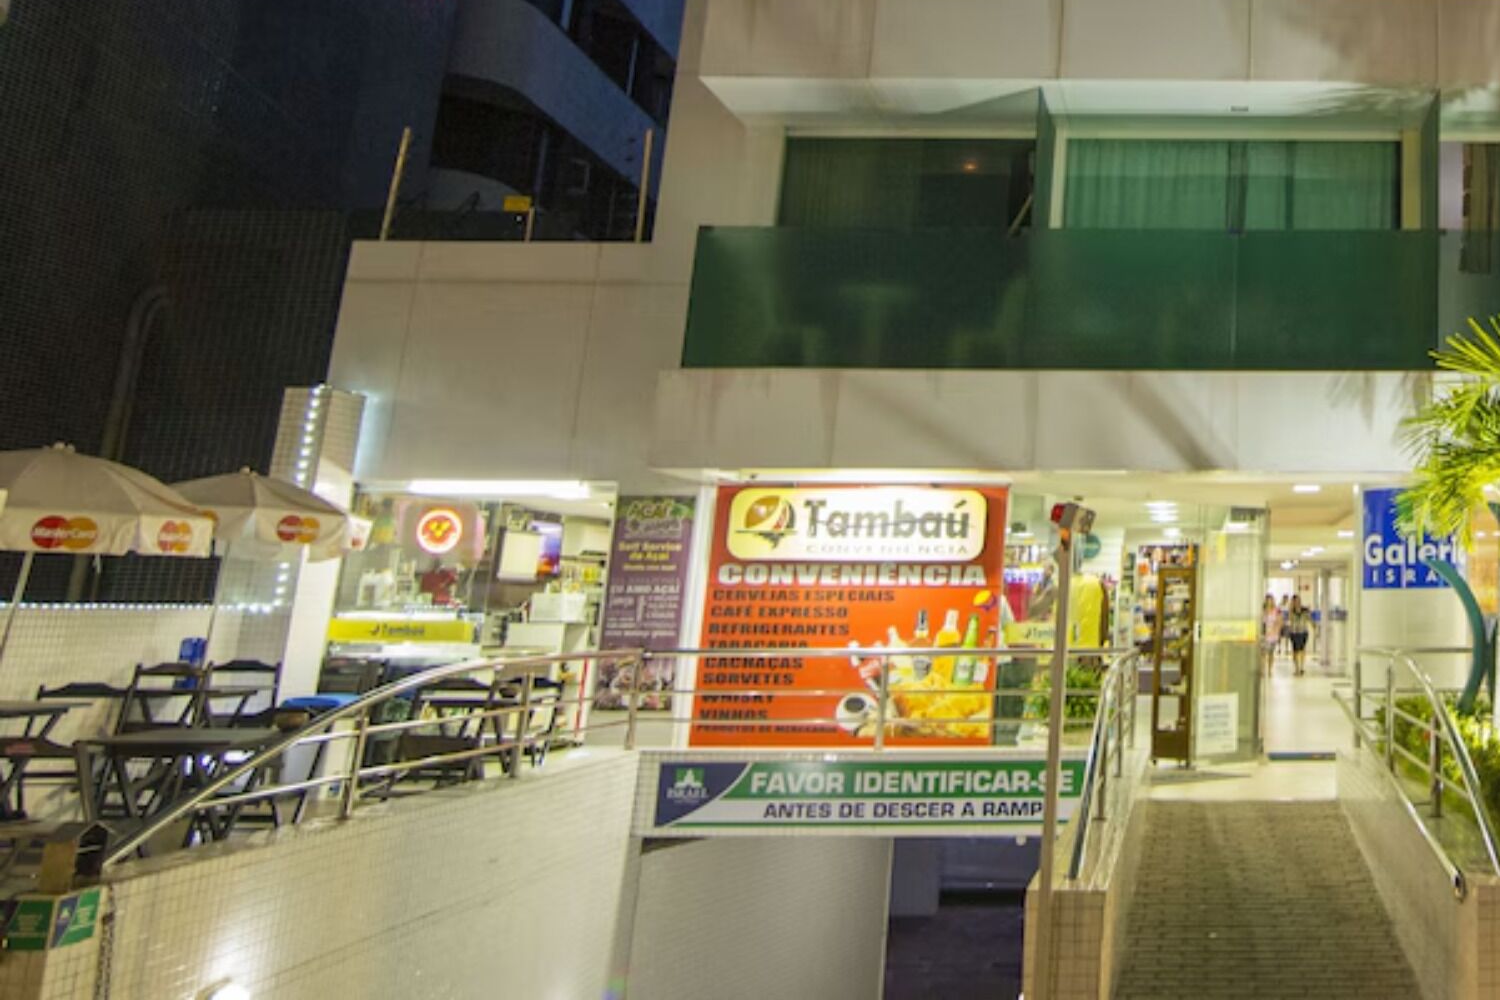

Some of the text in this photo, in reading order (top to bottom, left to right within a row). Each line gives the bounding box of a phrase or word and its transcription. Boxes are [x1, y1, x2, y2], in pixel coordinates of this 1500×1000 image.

[804, 499, 970, 539] Tambaú
[717, 562, 988, 587] CONVENIÊNCIA
[804, 590, 895, 601] ESPECIAIS
[758, 606, 848, 617] EXPRESSO
[708, 623, 850, 635] REFRIGERANTES
[705, 656, 804, 669] CACHAÇAS
[703, 673, 795, 685] SORVETES
[750, 770, 845, 793] FAVOR
[763, 801, 1044, 818] ANTES DE DESCER A RAMP
